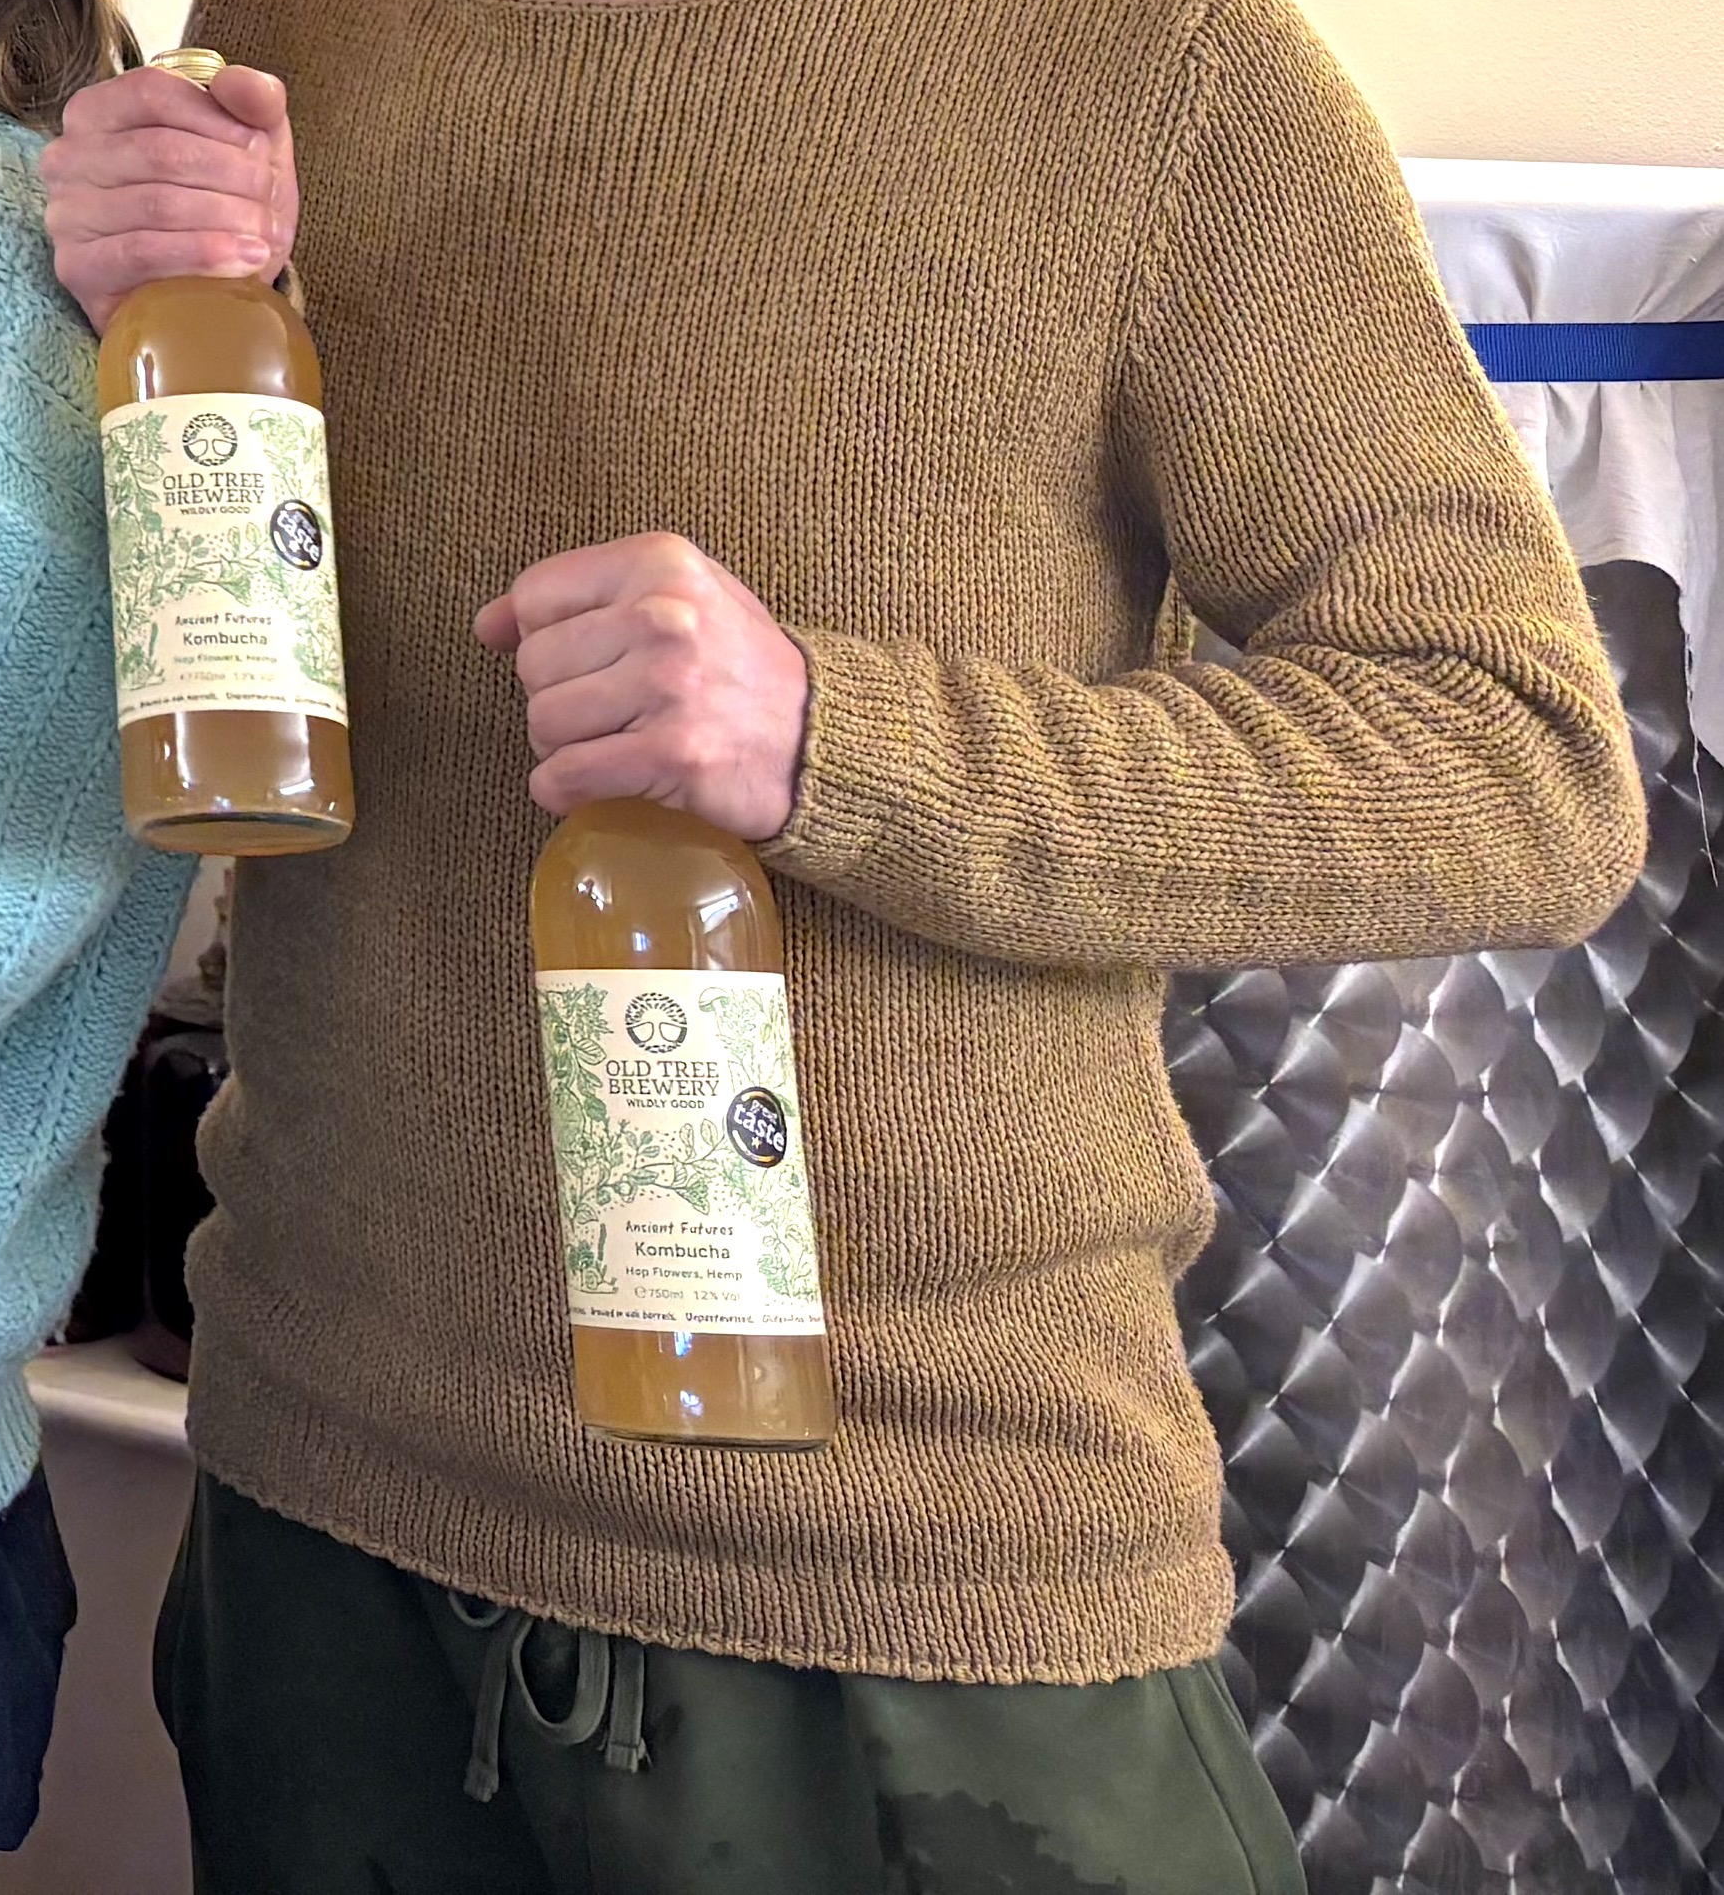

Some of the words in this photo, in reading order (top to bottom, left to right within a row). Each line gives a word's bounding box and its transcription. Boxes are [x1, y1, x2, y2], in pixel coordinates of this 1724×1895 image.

[162, 472, 205, 491] OLD
[209, 471, 265, 489] TREE
[163, 488, 265, 507] BREWERY
[183, 631, 268, 646] Kombucha
[605, 1059, 652, 1077] OLD
[656, 1060, 720, 1078] TREE
[608, 1078, 720, 1097] BREWERY
[626, 1098, 667, 1108] WILDLY
[670, 1099, 705, 1109] GOOD
[733, 1102, 786, 1153] taste
[625, 1220, 674, 1235] Ancient
[680, 1221, 734, 1236] Futures
[634, 1241, 731, 1260] Kombucha
[625, 1266, 650, 1279] Hop
[706, 1268, 743, 1281] Hemp
